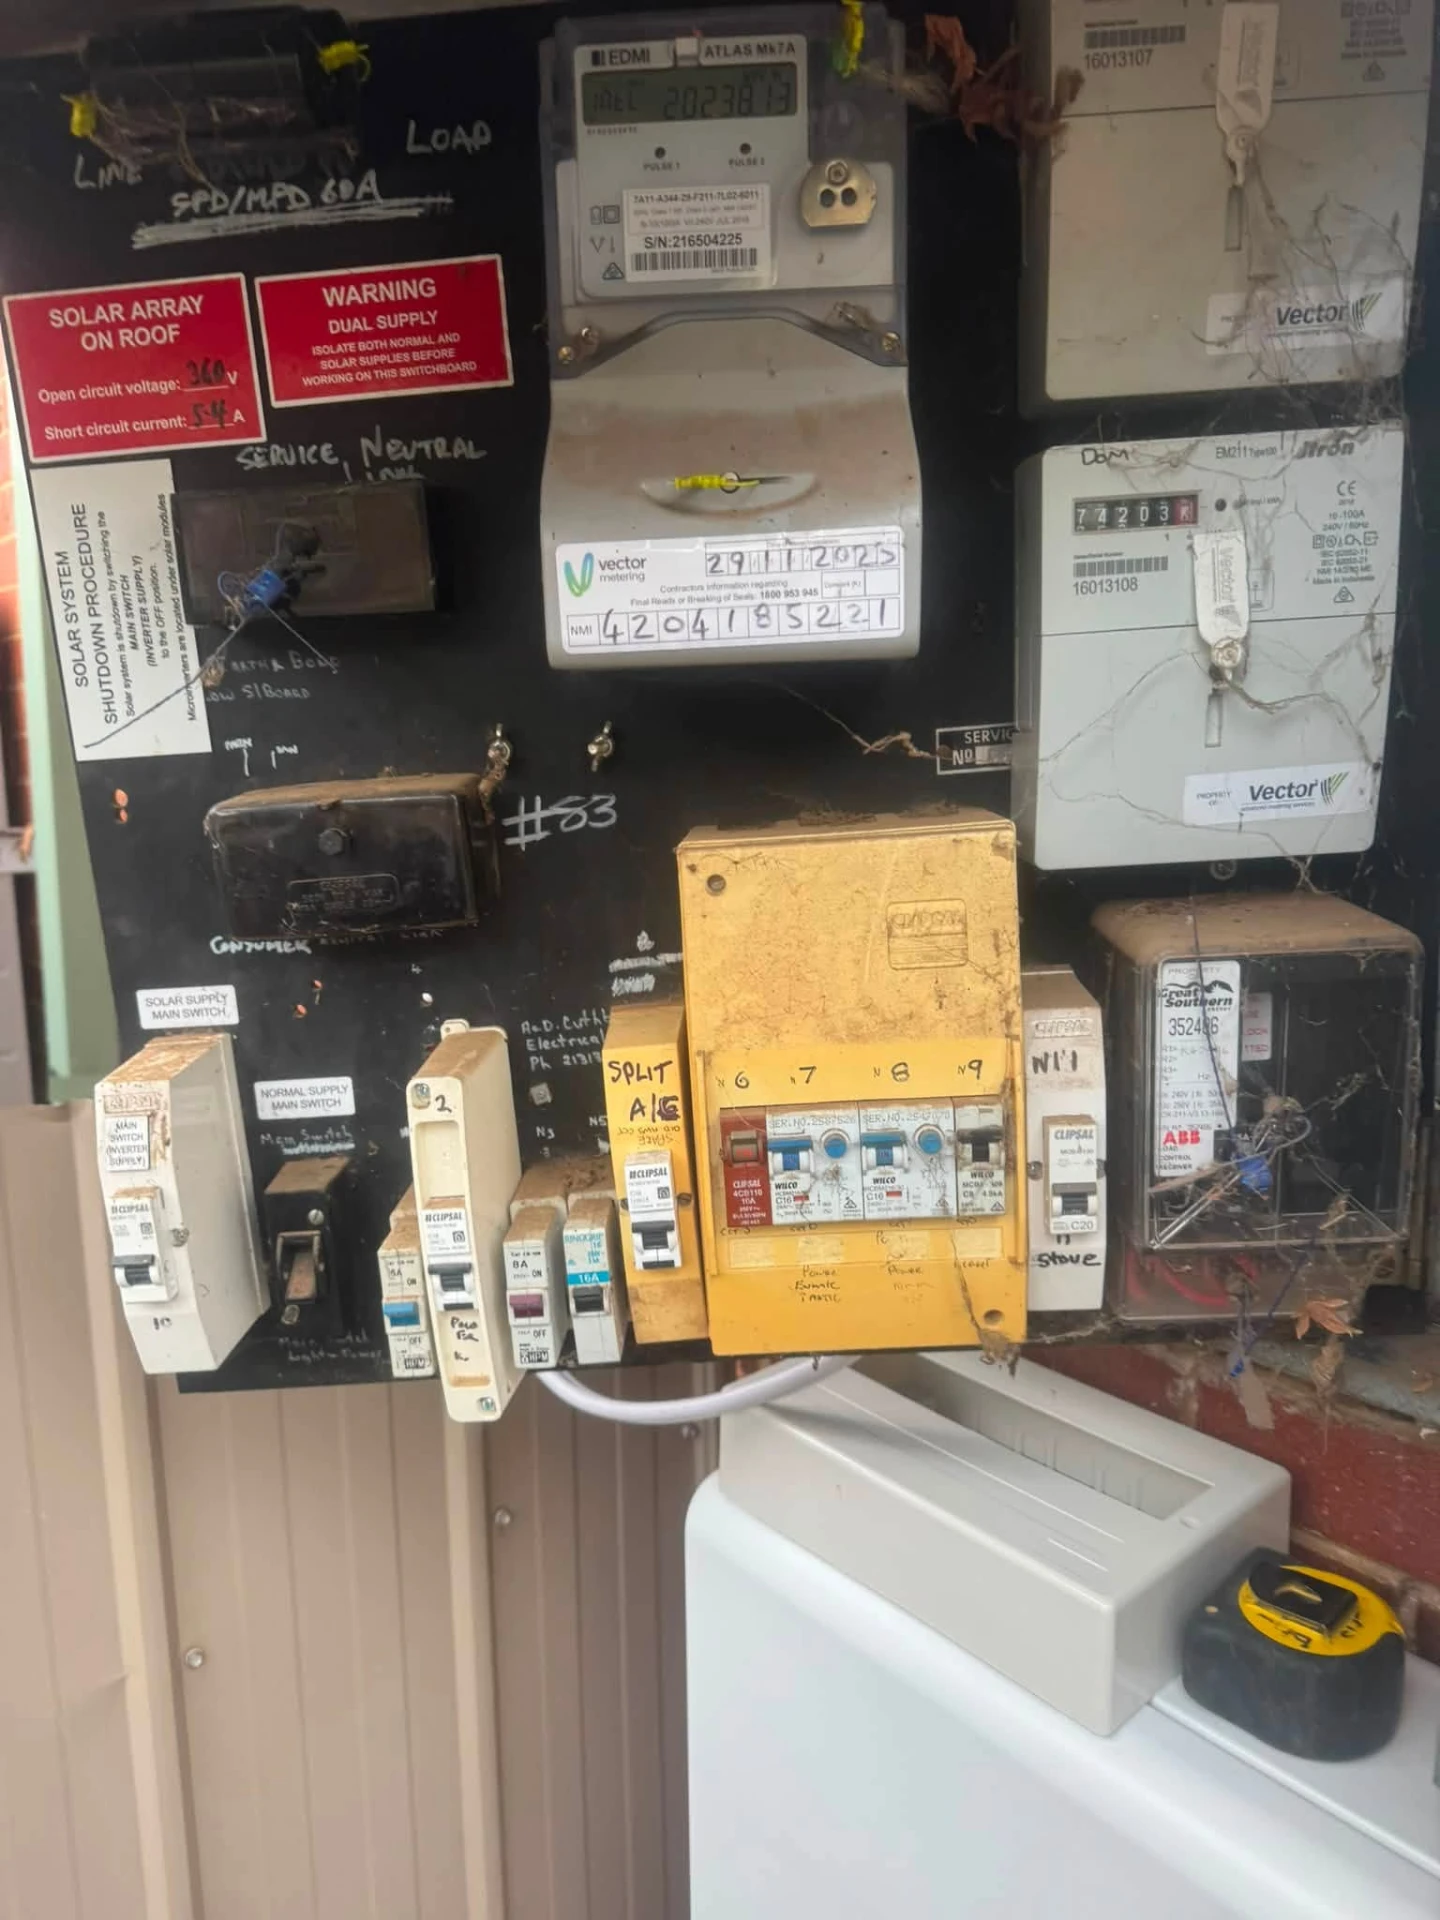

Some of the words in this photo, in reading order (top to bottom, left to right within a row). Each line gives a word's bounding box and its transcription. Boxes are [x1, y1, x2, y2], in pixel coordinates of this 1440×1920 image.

[609, 48, 650, 66] EDMI
[704, 43, 753, 58] ATLAS
[1085, 49, 1154, 70] 16013107
[405, 119, 492, 155] LOAD
[322, 278, 437, 308] WARNING
[49, 303, 124, 329] SOLAR
[131, 295, 204, 319] ARRAY
[1275, 302, 1348, 326] Vector
[328, 317, 373, 335] DUAL
[376, 310, 438, 330] SUPPLY
[81, 331, 114, 352] ON
[119, 324, 180, 348] ROOF
[312, 339, 357, 356] ISOLATE
[358, 338, 388, 353] BOTH
[389, 334, 436, 350] NORMAL
[438, 332, 461, 344] AND
[320, 356, 357, 370] SOLAR
[359, 352, 410, 368] SUPPLIES
[412, 348, 456, 363] BEFORE
[302, 371, 354, 387] WORKING
[355, 370, 372, 382] ON
[374, 366, 398, 380] THIS
[399, 361, 477, 378] SWITCHBOARD
[38, 388, 76, 406] Open
[79, 382, 123, 399] circuit
[125, 379, 181, 397] voltage:
[227, 371, 238, 386] V
[44, 424, 84, 441] Short
[86, 419, 130, 438] circuit
[131, 415, 188, 433] current:
[233, 409, 246, 423] A
[235, 442, 340, 471] SERVICE
[359, 425, 487, 468] NEUTRAL
[98, 511, 108, 527] the
[158, 493, 171, 537] modules
[71, 502, 102, 617] PROCEDURE
[101, 530, 115, 577] switching
[164, 539, 174, 564] solar
[598, 556, 647, 571] vector
[57, 550, 79, 624] SYSTEM
[108, 579, 118, 591] by
[133, 555, 148, 604] SUPPLY)
[150, 562, 165, 604] position.
[168, 567, 179, 596] under
[599, 572, 646, 583] metering
[706, 581, 749, 591] information
[750, 580, 789, 592] regarding
[1073, 577, 1139, 596] 16013108
[121, 574, 135, 620] SWITCH
[630, 599, 650, 607] Final
[760, 591, 781, 600] 1800
[784, 589, 800, 598] 953
[802, 588, 819, 597] 945
[111, 593, 125, 641] shutdown
[156, 606, 166, 628] OFF
[172, 597, 184, 633] located
[129, 622, 140, 651] MAIN
[140, 606, 158, 668] (INVERTER
[160, 631, 169, 647] the
[570, 625, 593, 637] NMI
[116, 643, 126, 653] is
[180, 634, 188, 652] are
[66, 629, 90, 688] SOLAR
[163, 649, 171, 659] to
[89, 622, 118, 725] SHUTDOWN
[119, 654, 134, 689] system
[127, 690, 136, 718] Solar
[1249, 781, 1318, 802] Vector
[145, 996, 183, 1007] SOLAR
[186, 992, 229, 1006] SUPPLY
[152, 1010, 182, 1021] MAIN
[183, 1008, 226, 1019] SWITCH
[529, 1055, 553, 1072] Ph
[607, 1060, 674, 1086] SPLIT
[967, 1059, 983, 1080] 9
[734, 1071, 750, 1089] 6
[799, 1065, 817, 1084] 7
[260, 1087, 307, 1099] NORMAL
[308, 1084, 349, 1096] SUPPLY
[271, 1100, 300, 1111] MAIN
[301, 1098, 342, 1109] SWITCH
[435, 1094, 453, 1113] 2
[115, 1120, 138, 1132] MAIN
[1053, 1129, 1095, 1140] CLIPSAL
[110, 1132, 145, 1142] SWITCH
[1162, 1129, 1201, 1145] ABB
[105, 1144, 148, 1156] (INVERTER
[636, 1166, 668, 1179] CLIPSAL
[872, 1176, 897, 1184] WILCO
[970, 1171, 995, 1180] WILCO
[774, 1181, 798, 1190] WILCO
[118, 1203, 149, 1214] CLIPSAL
[432, 1212, 463, 1222] CLIPSAL
[1070, 1220, 1094, 1231] C20
[406, 1277, 417, 1286] ON
[531, 1269, 543, 1278] ON
[577, 1273, 601, 1284] 16A
[409, 1337, 422, 1345] OFF
[533, 1329, 547, 1338] OFF
